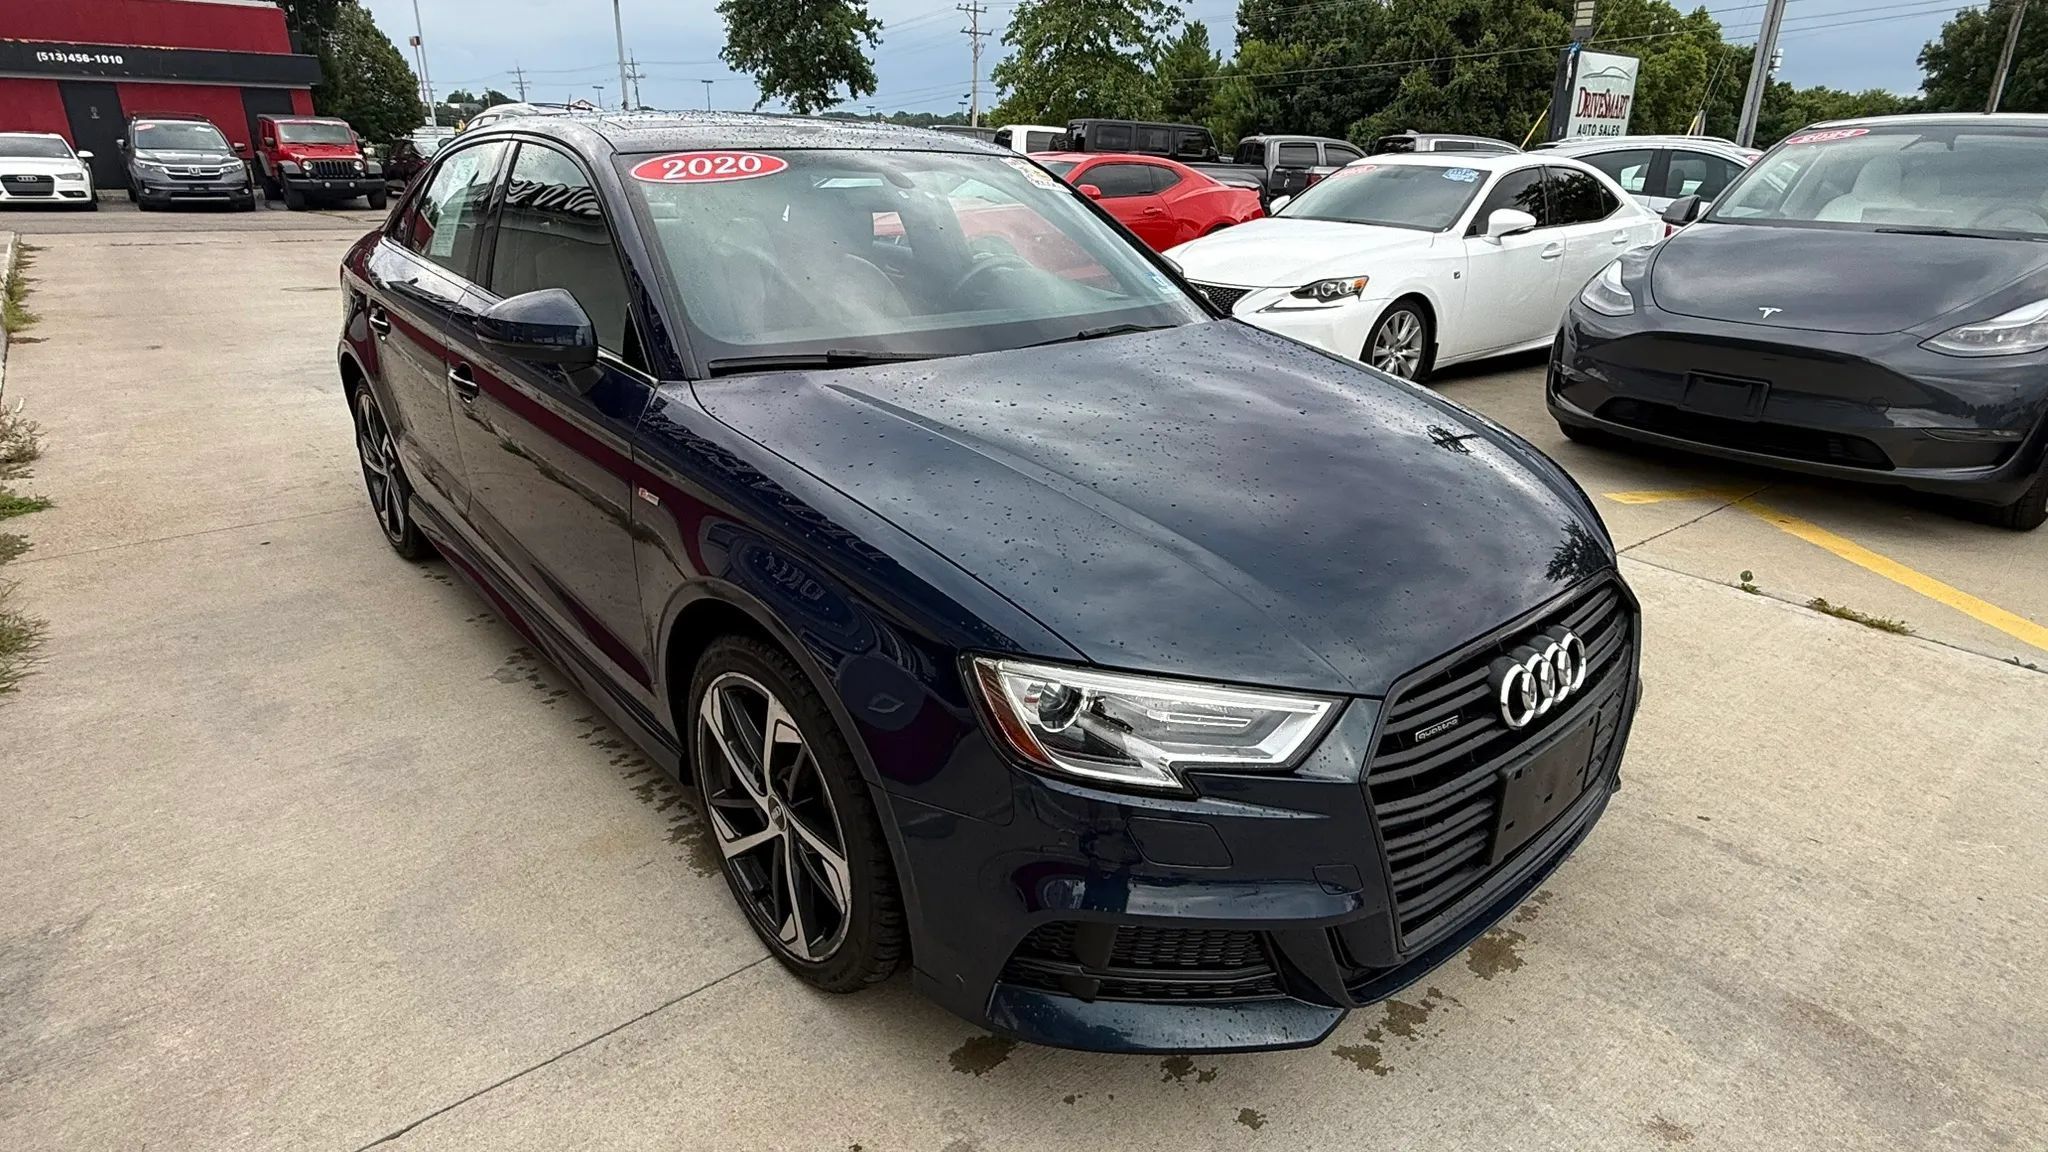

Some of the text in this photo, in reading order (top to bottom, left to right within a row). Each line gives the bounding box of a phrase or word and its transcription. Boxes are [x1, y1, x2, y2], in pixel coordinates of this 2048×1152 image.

[1577, 124, 1620, 136] AUTO SALES
[662, 155, 762, 180] 2020
[1417, 718, 1459, 740] quattro
